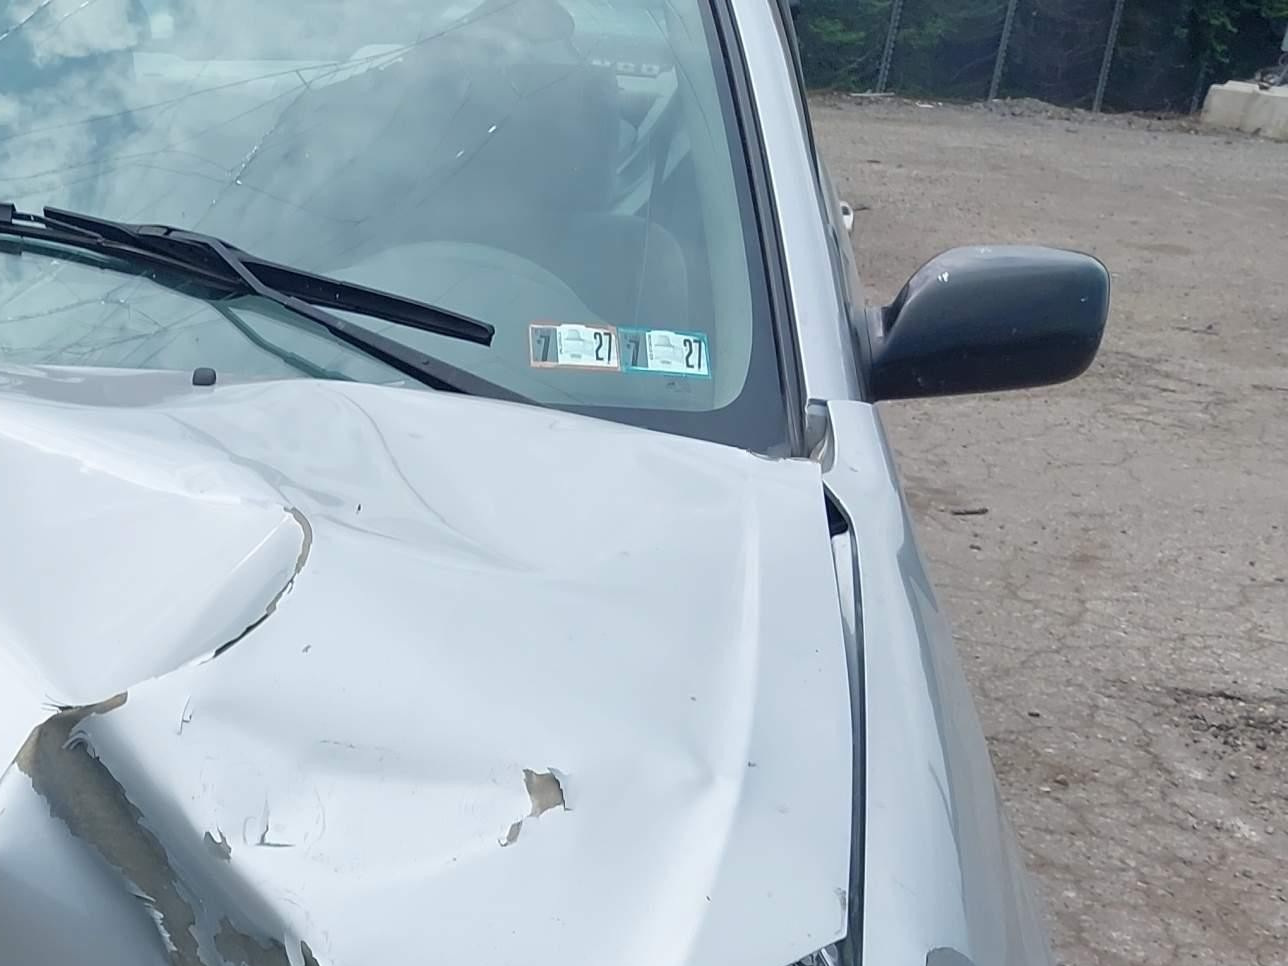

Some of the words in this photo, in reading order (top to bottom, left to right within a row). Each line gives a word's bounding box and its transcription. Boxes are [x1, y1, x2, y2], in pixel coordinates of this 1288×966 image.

[539, 335, 550, 361] 7
[593, 332, 612, 363] 27
[628, 339, 640, 366] 7
[683, 338, 702, 370] 27
